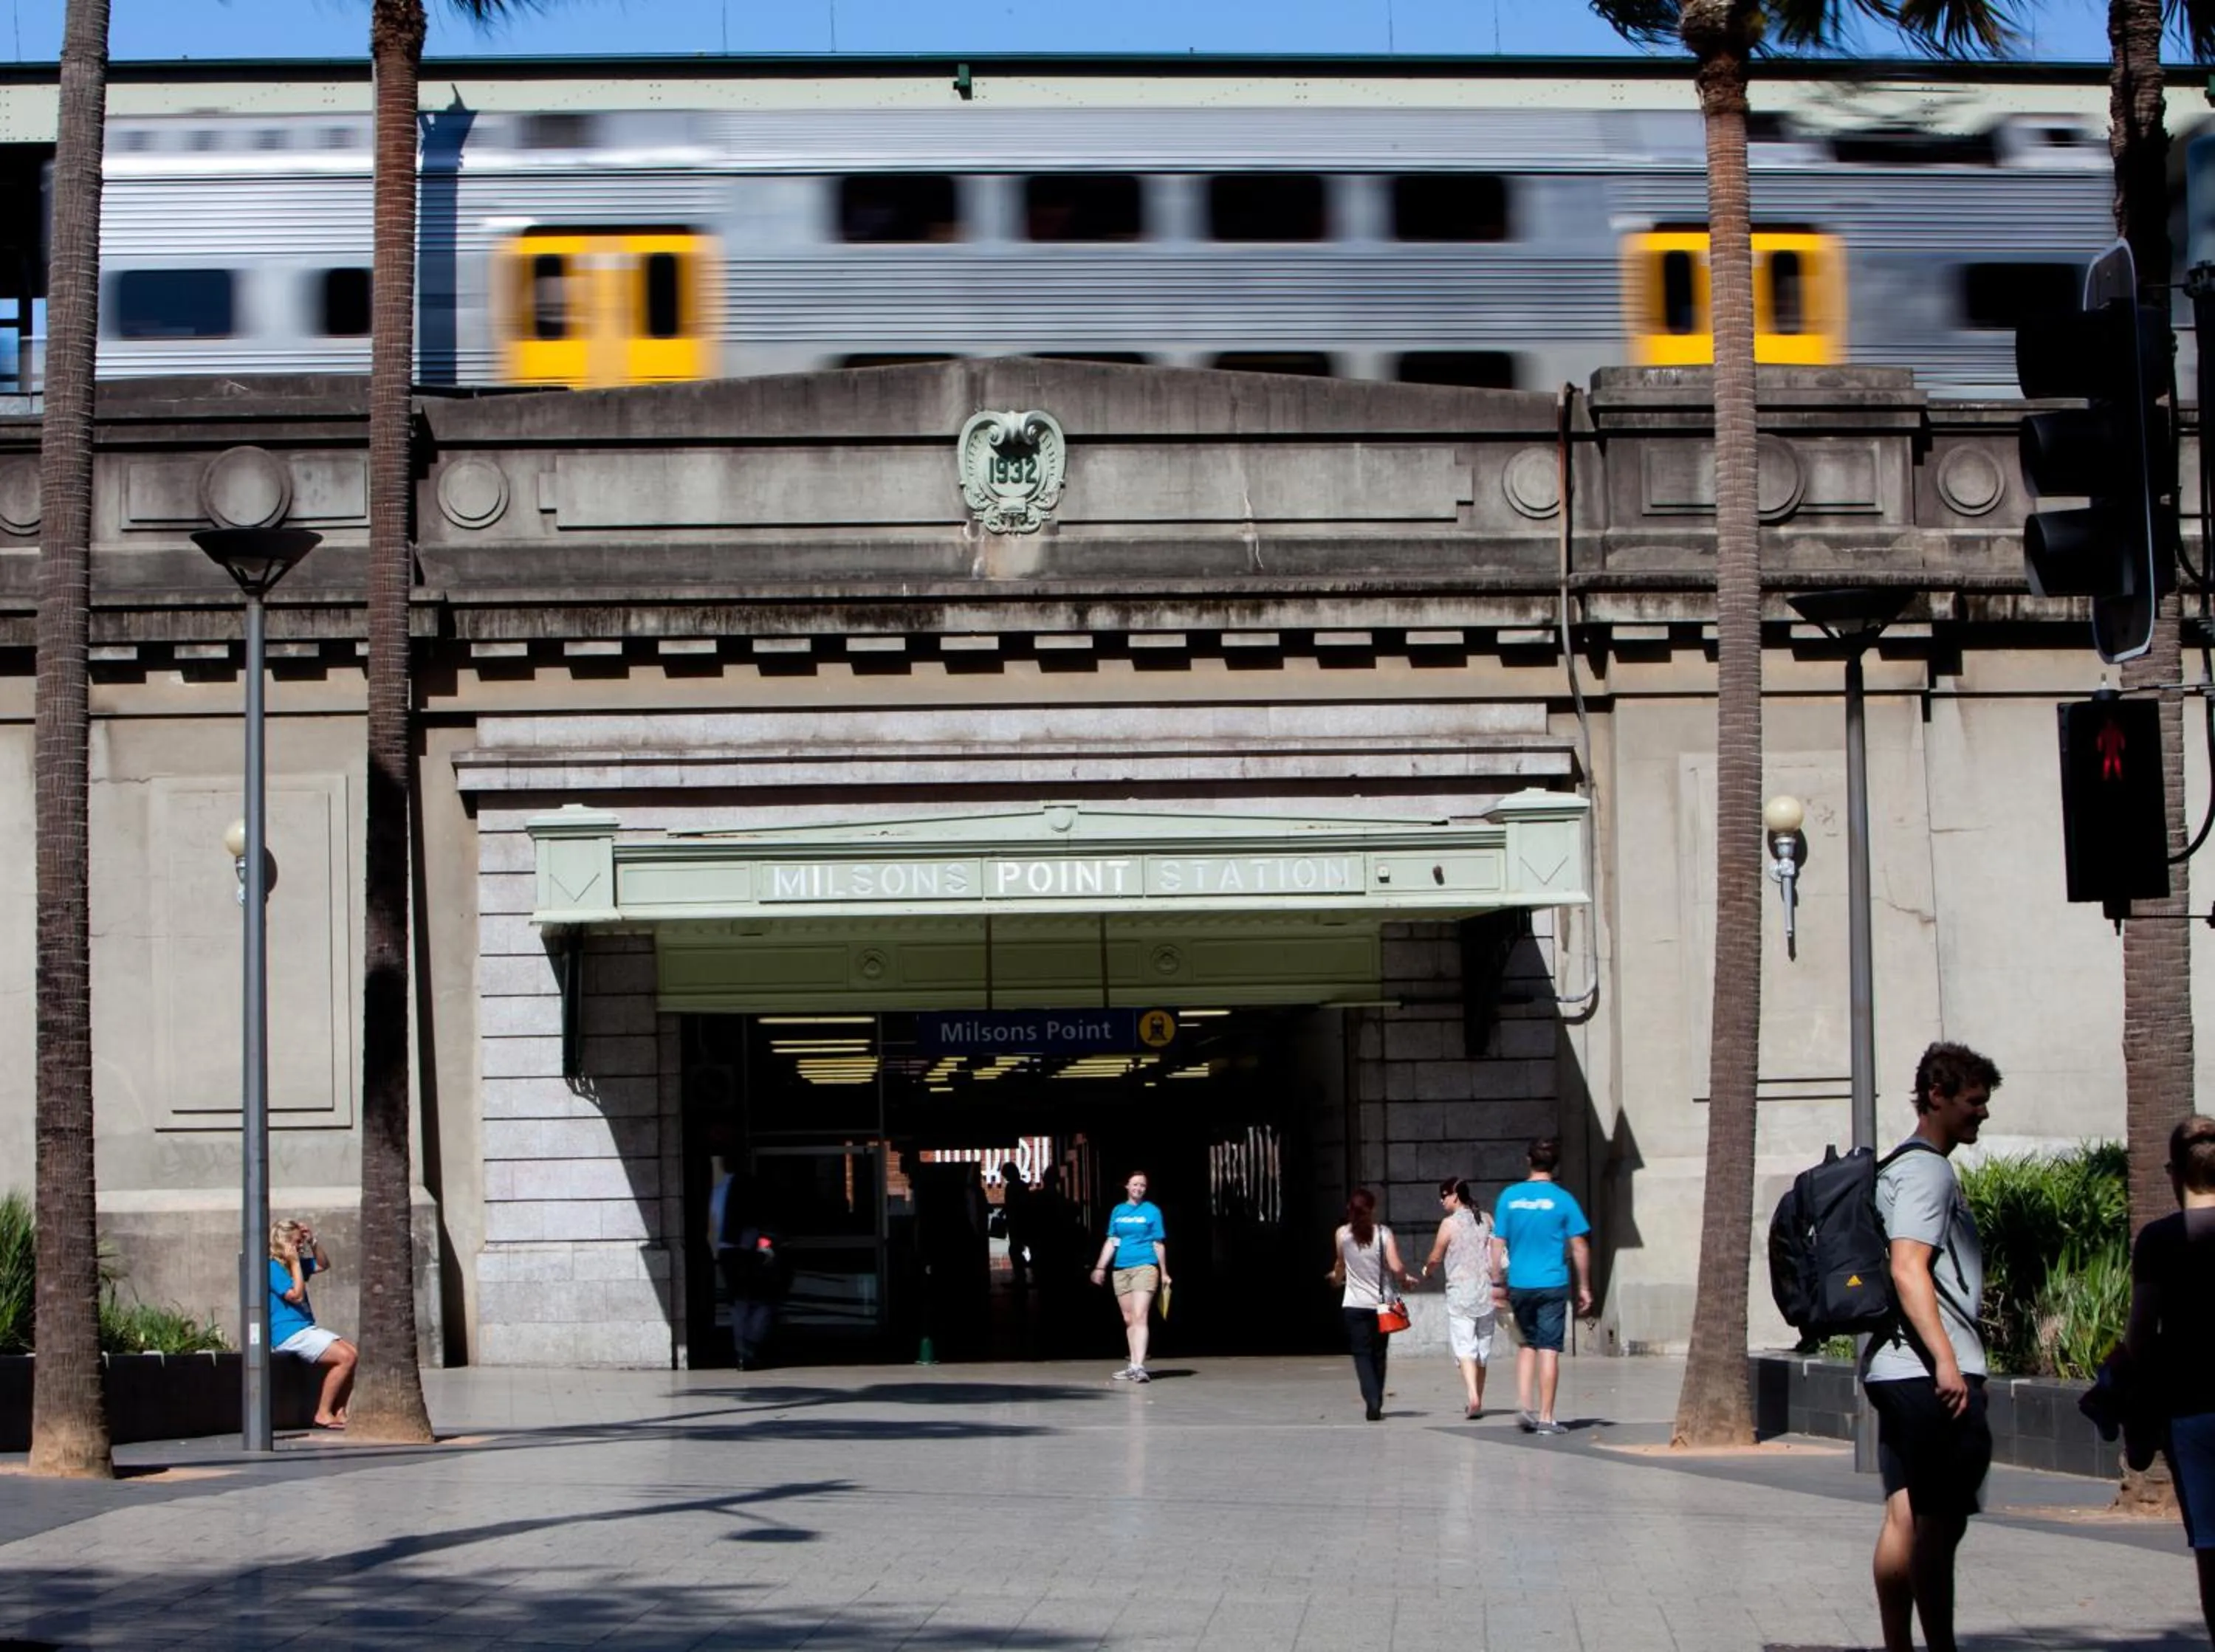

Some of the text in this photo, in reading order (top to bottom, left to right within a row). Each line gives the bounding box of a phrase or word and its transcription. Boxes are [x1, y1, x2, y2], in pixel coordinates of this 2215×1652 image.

[989, 456, 1037, 484] 1932
[775, 857, 1349, 897] MILSONS POINT STATION
[941, 1019, 1113, 1042] Milsons Point
